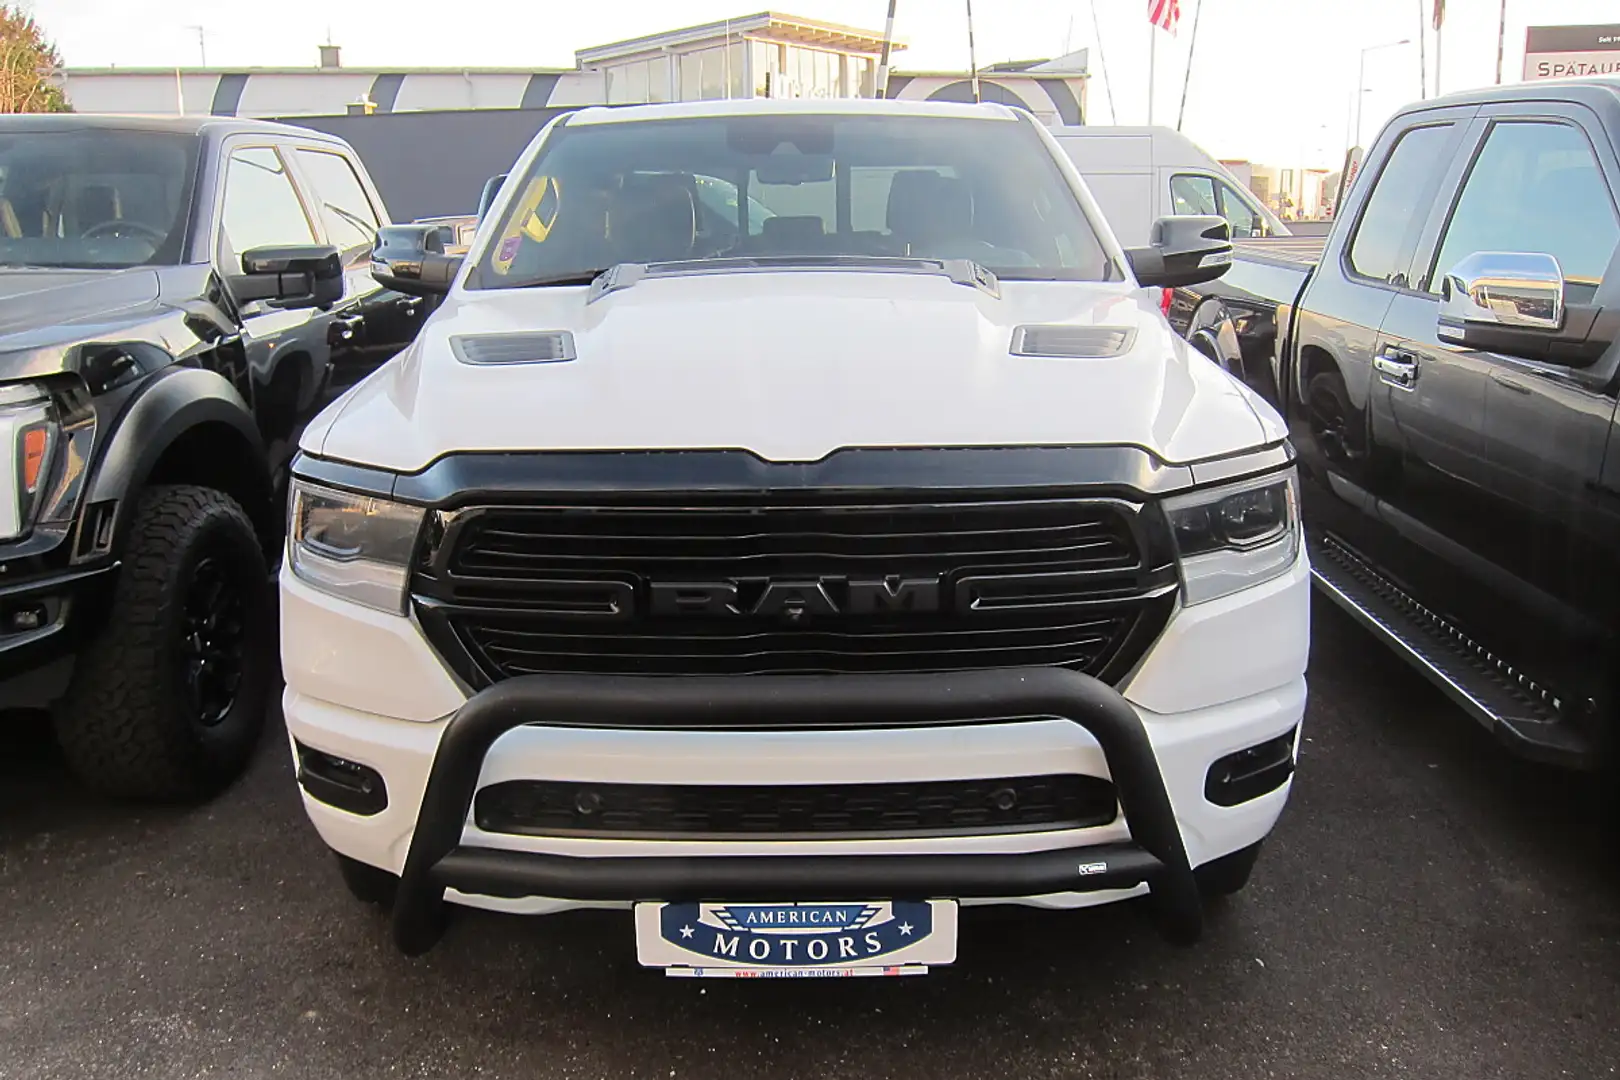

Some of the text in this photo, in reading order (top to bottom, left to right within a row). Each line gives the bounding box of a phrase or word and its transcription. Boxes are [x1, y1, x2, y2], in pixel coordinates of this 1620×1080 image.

[650, 576, 939, 614] RAM
[746, 910, 848, 924] AMERICAN
[713, 931, 882, 960] MOTORS
[735, 968, 855, 978] www.american-motors.at
